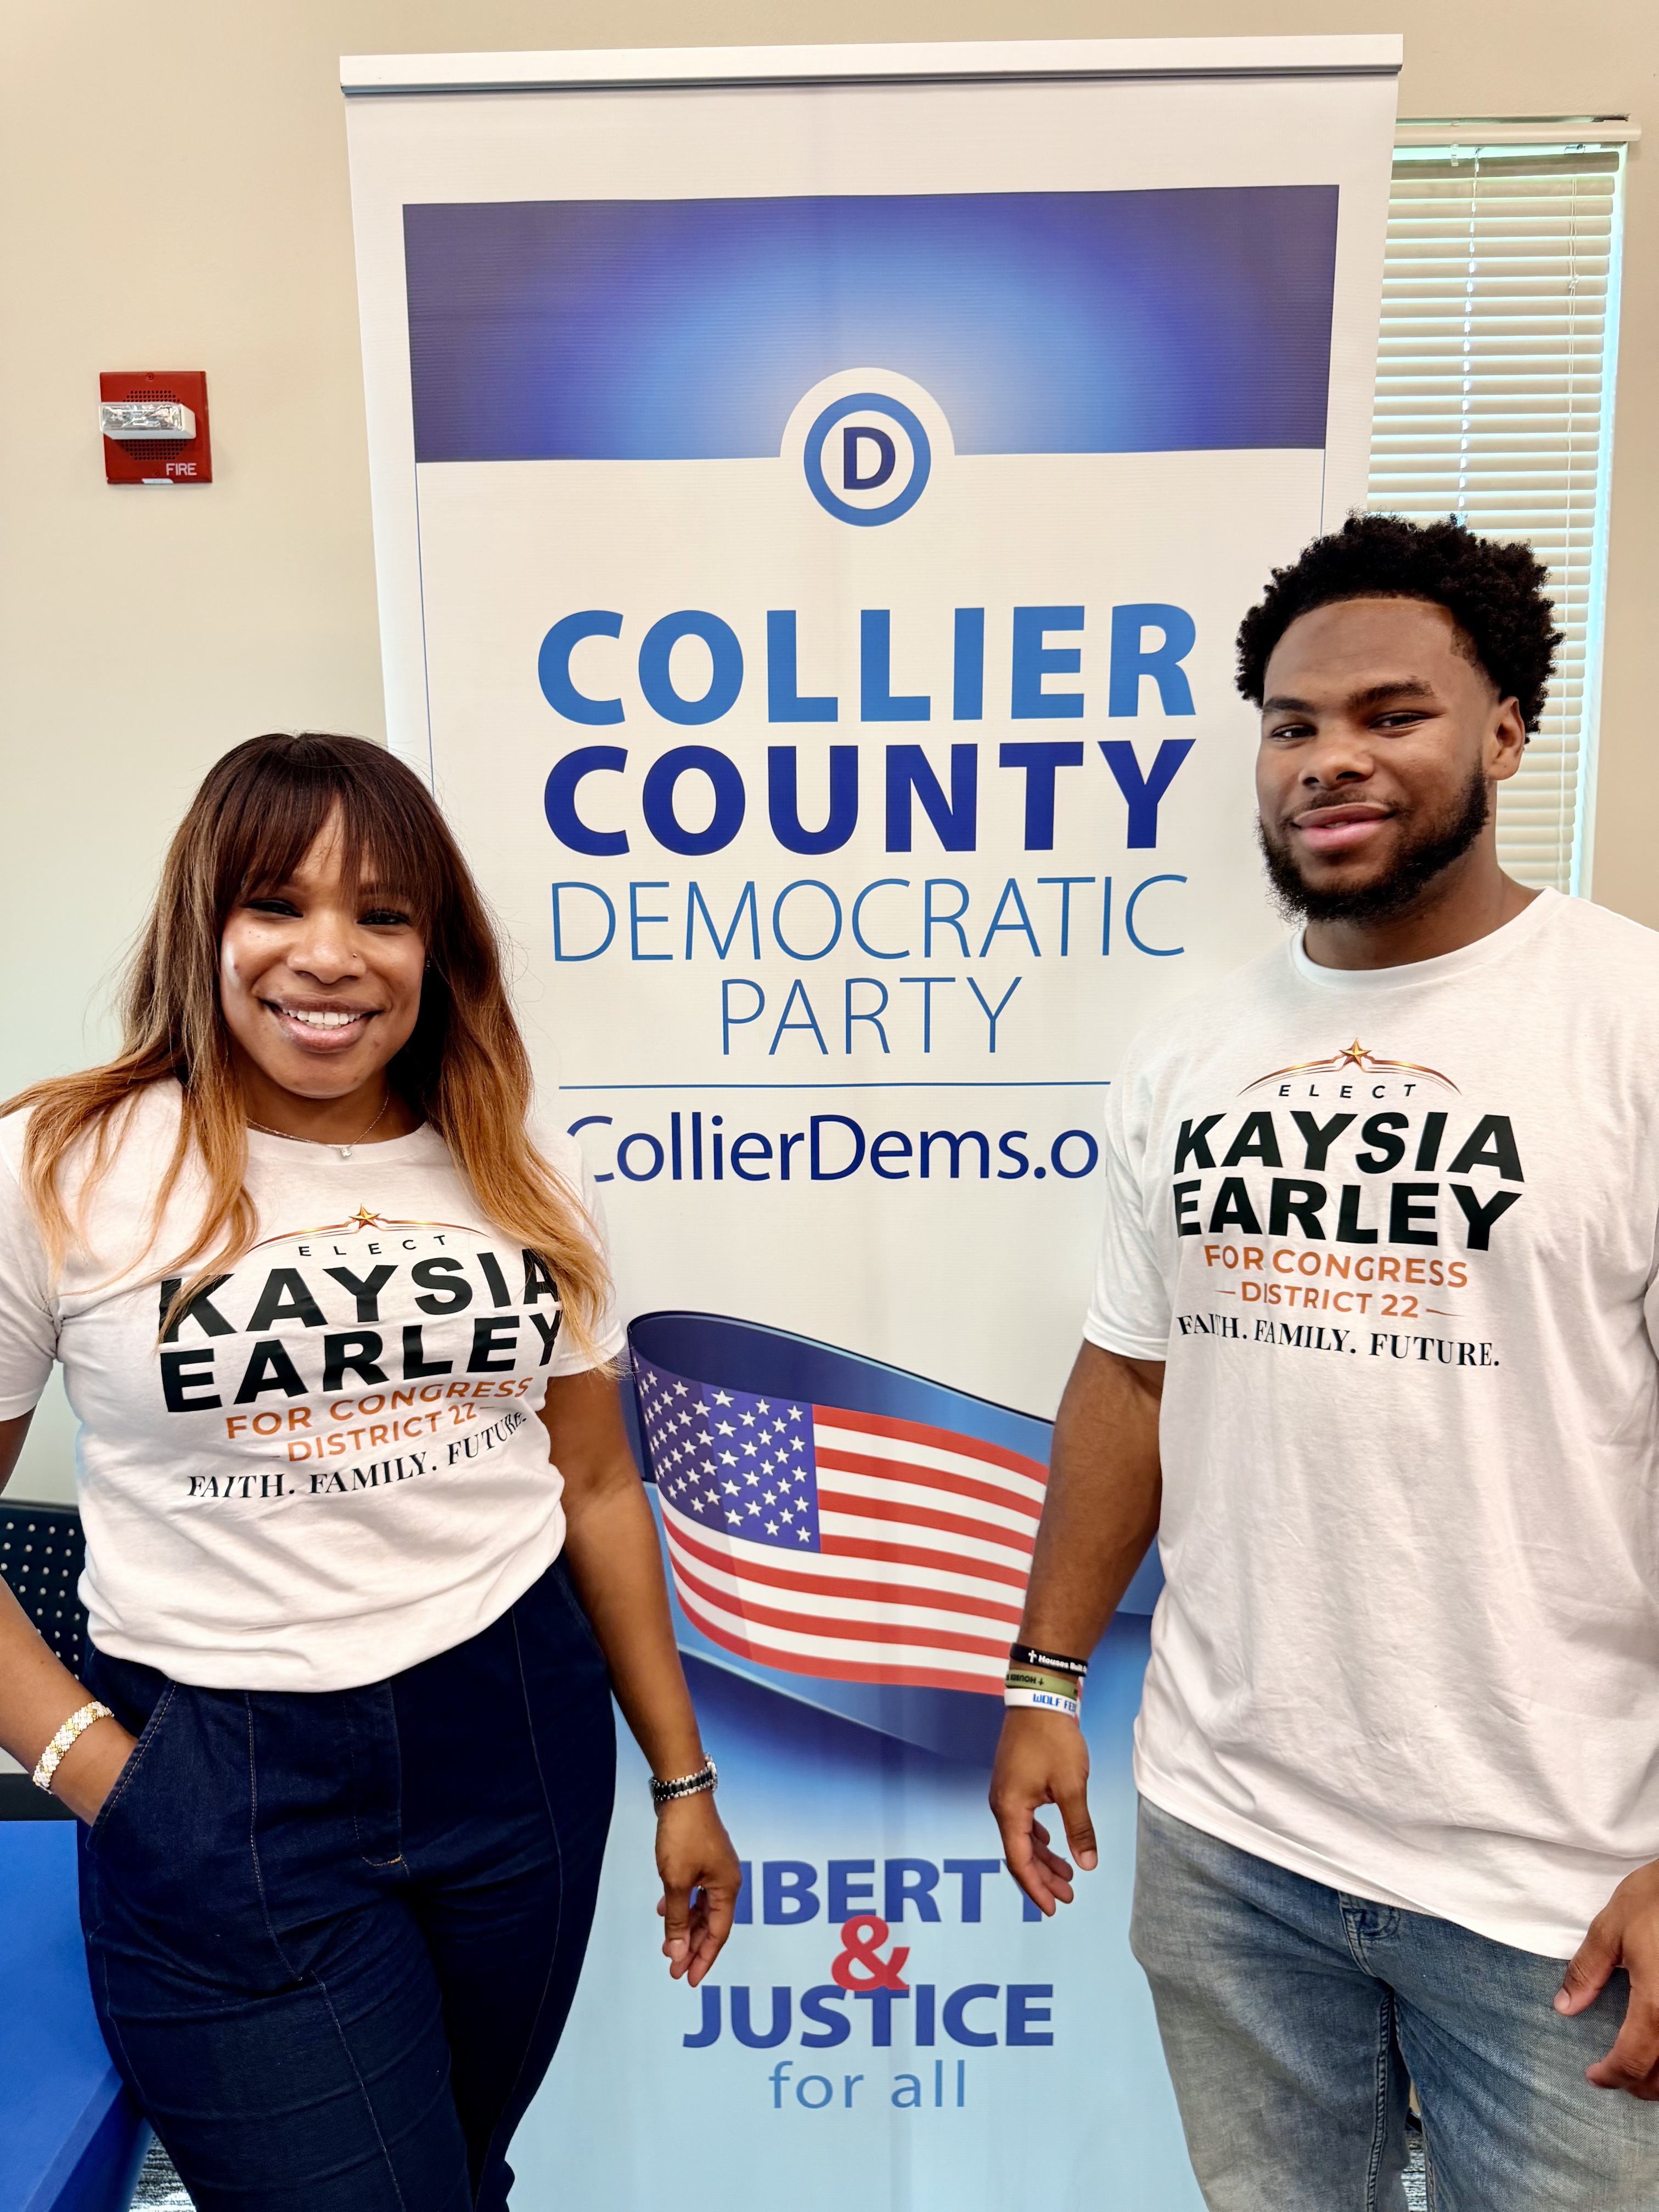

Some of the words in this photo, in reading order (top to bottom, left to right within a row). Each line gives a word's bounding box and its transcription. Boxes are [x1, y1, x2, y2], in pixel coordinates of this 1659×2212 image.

[166, 463, 197, 476] FIRE
[843, 426, 896, 490] D
[538, 603, 1196, 725] COLLIER
[544, 739, 1196, 856] COUNTY
[552, 874, 1188, 961] DEMOCRATIC
[722, 976, 1022, 1055] PARTY
[1278, 1084, 1416, 1099] ELECT
[1173, 1111, 1525, 1183] KAYSIA
[299, 1235, 446, 1257] ELECT
[1173, 1177, 1523, 1251] EARLEY
[158, 1248, 563, 1343] KAYSIA
[1204, 1245, 1264, 1271] FOR
[1272, 1249, 1468, 1288] CONGRESS
[1242, 1282, 1372, 1314] DISTRICT
[1381, 1294, 1419, 1318] 22
[160, 1309, 564, 1412] EARLEY
[1176, 1313, 1247, 1339] FAITH.
[1253, 1319, 1356, 1354] FAMILY.
[1369, 1332, 1500, 1366] FUTURE.
[226, 1406, 312, 1439] FOR
[330, 1376, 533, 1420] CONGRESS
[287, 1411, 442, 1462] DISTRICT
[448, 1402, 477, 1425] 22
[187, 1472, 295, 1498] FAITH.
[310, 1450, 438, 1494] FAMILY.
[447, 1411, 527, 1460] FUTURE.
[1039, 1654, 1069, 1669] Houses
[1033, 1693, 1062, 1707] WOLF
[689, 1858, 1067, 1925] IBERT
[831, 1914, 910, 1991] &
[683, 1983, 1054, 2048] JUSTICE
[768, 2061, 864, 2108] for
[891, 2059, 965, 2108] all
